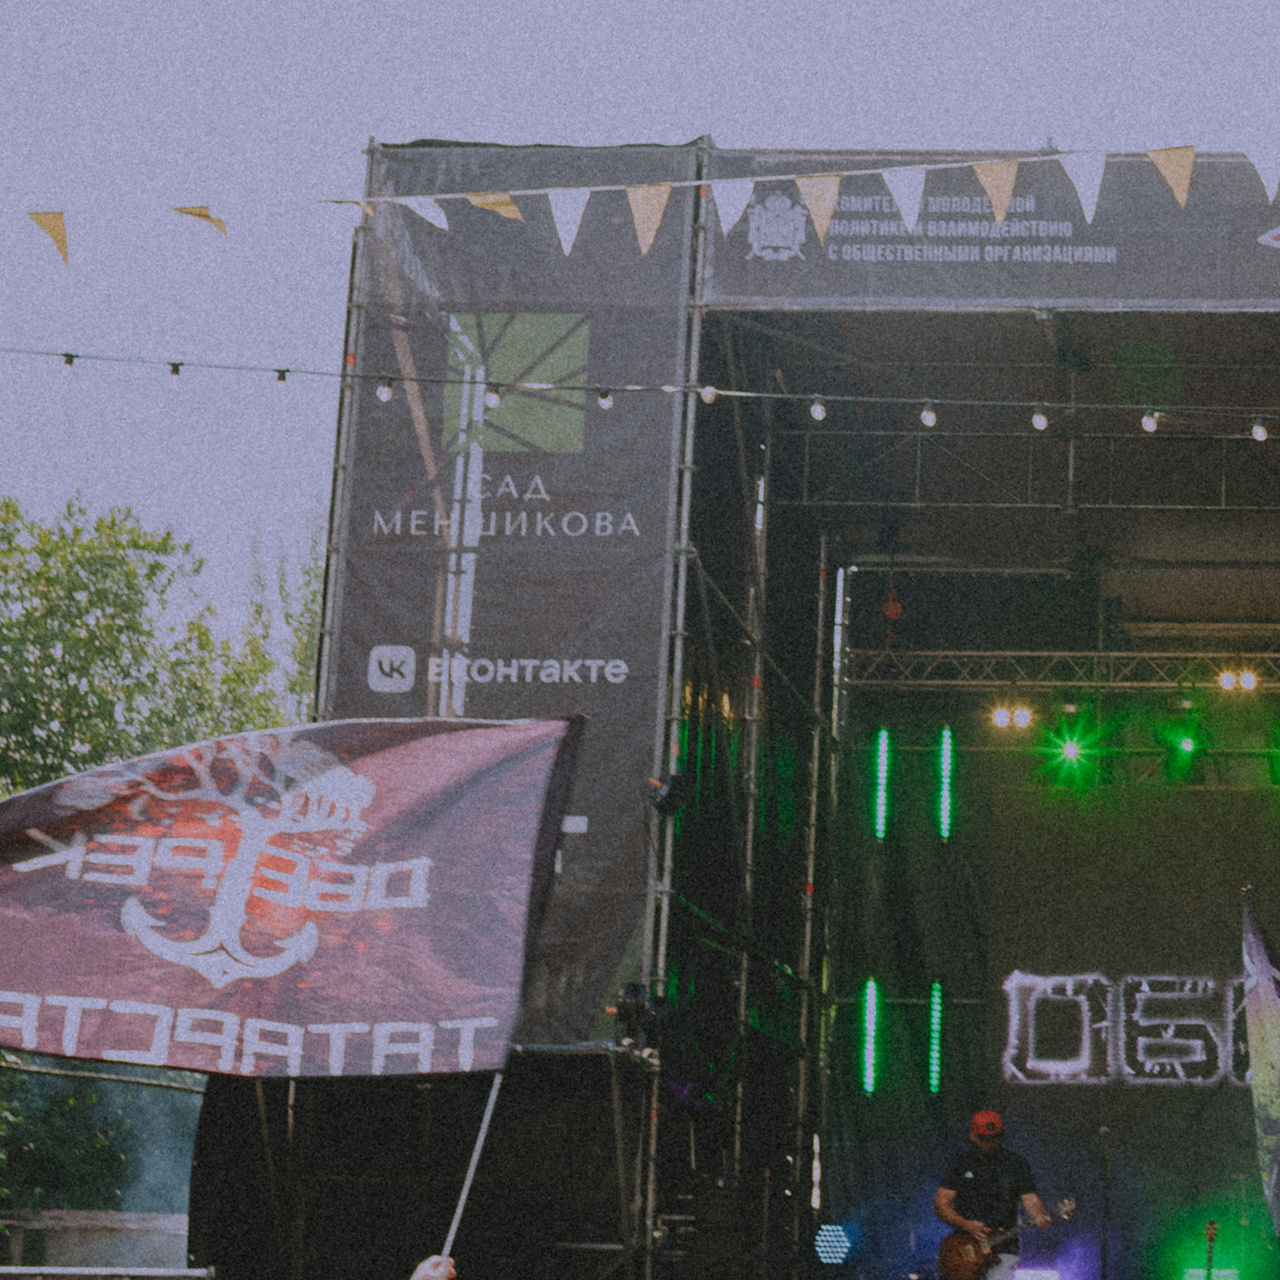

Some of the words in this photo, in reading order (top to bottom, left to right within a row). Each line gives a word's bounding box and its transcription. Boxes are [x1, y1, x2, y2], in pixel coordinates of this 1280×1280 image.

[926, 217, 1073, 239] ВЗАИМОДЕЙСТВИЮ
[827, 245, 838, 262] С
[842, 243, 981, 263] ОБЩЕСТВЕННЫМИ
[984, 245, 1118, 265] ОРГАНИЗАЦИЯМИ
